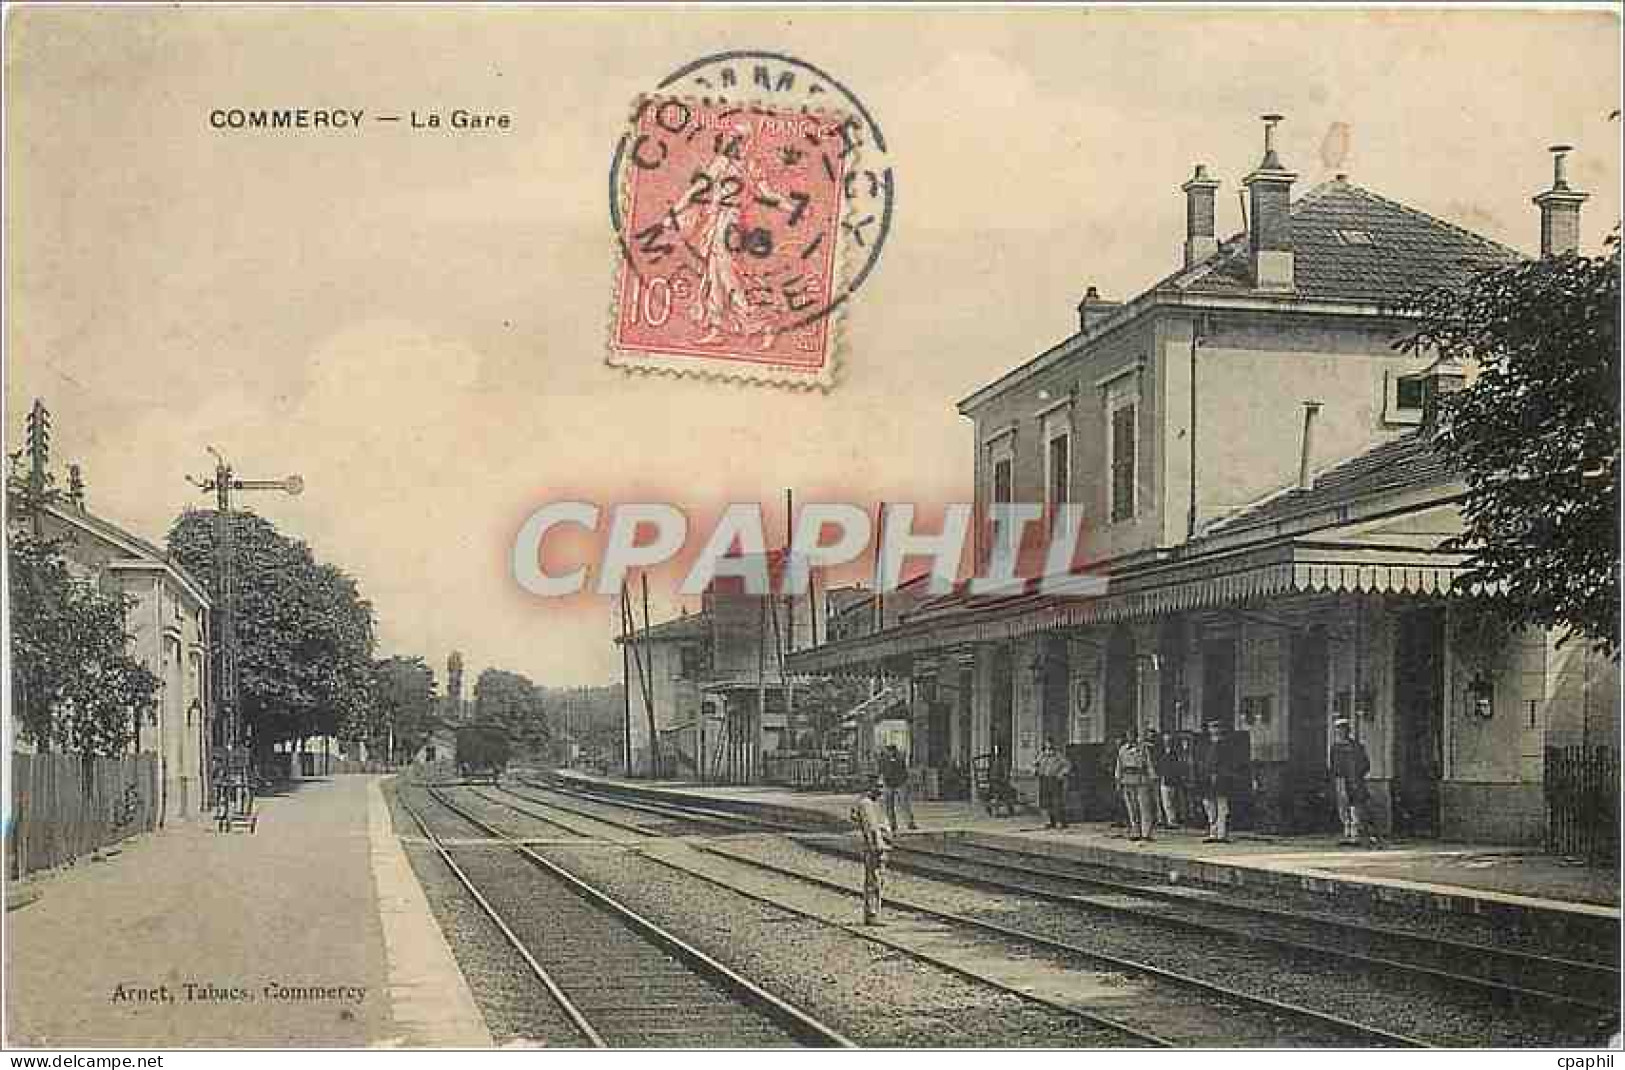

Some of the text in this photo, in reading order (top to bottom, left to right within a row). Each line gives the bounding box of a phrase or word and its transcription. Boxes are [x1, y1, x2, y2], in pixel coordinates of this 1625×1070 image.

[209, 109, 365, 129] COMMERCY
[410, 110, 441, 129] La
[450, 109, 512, 129] Gare
[263, 981, 367, 1004] Commercy
